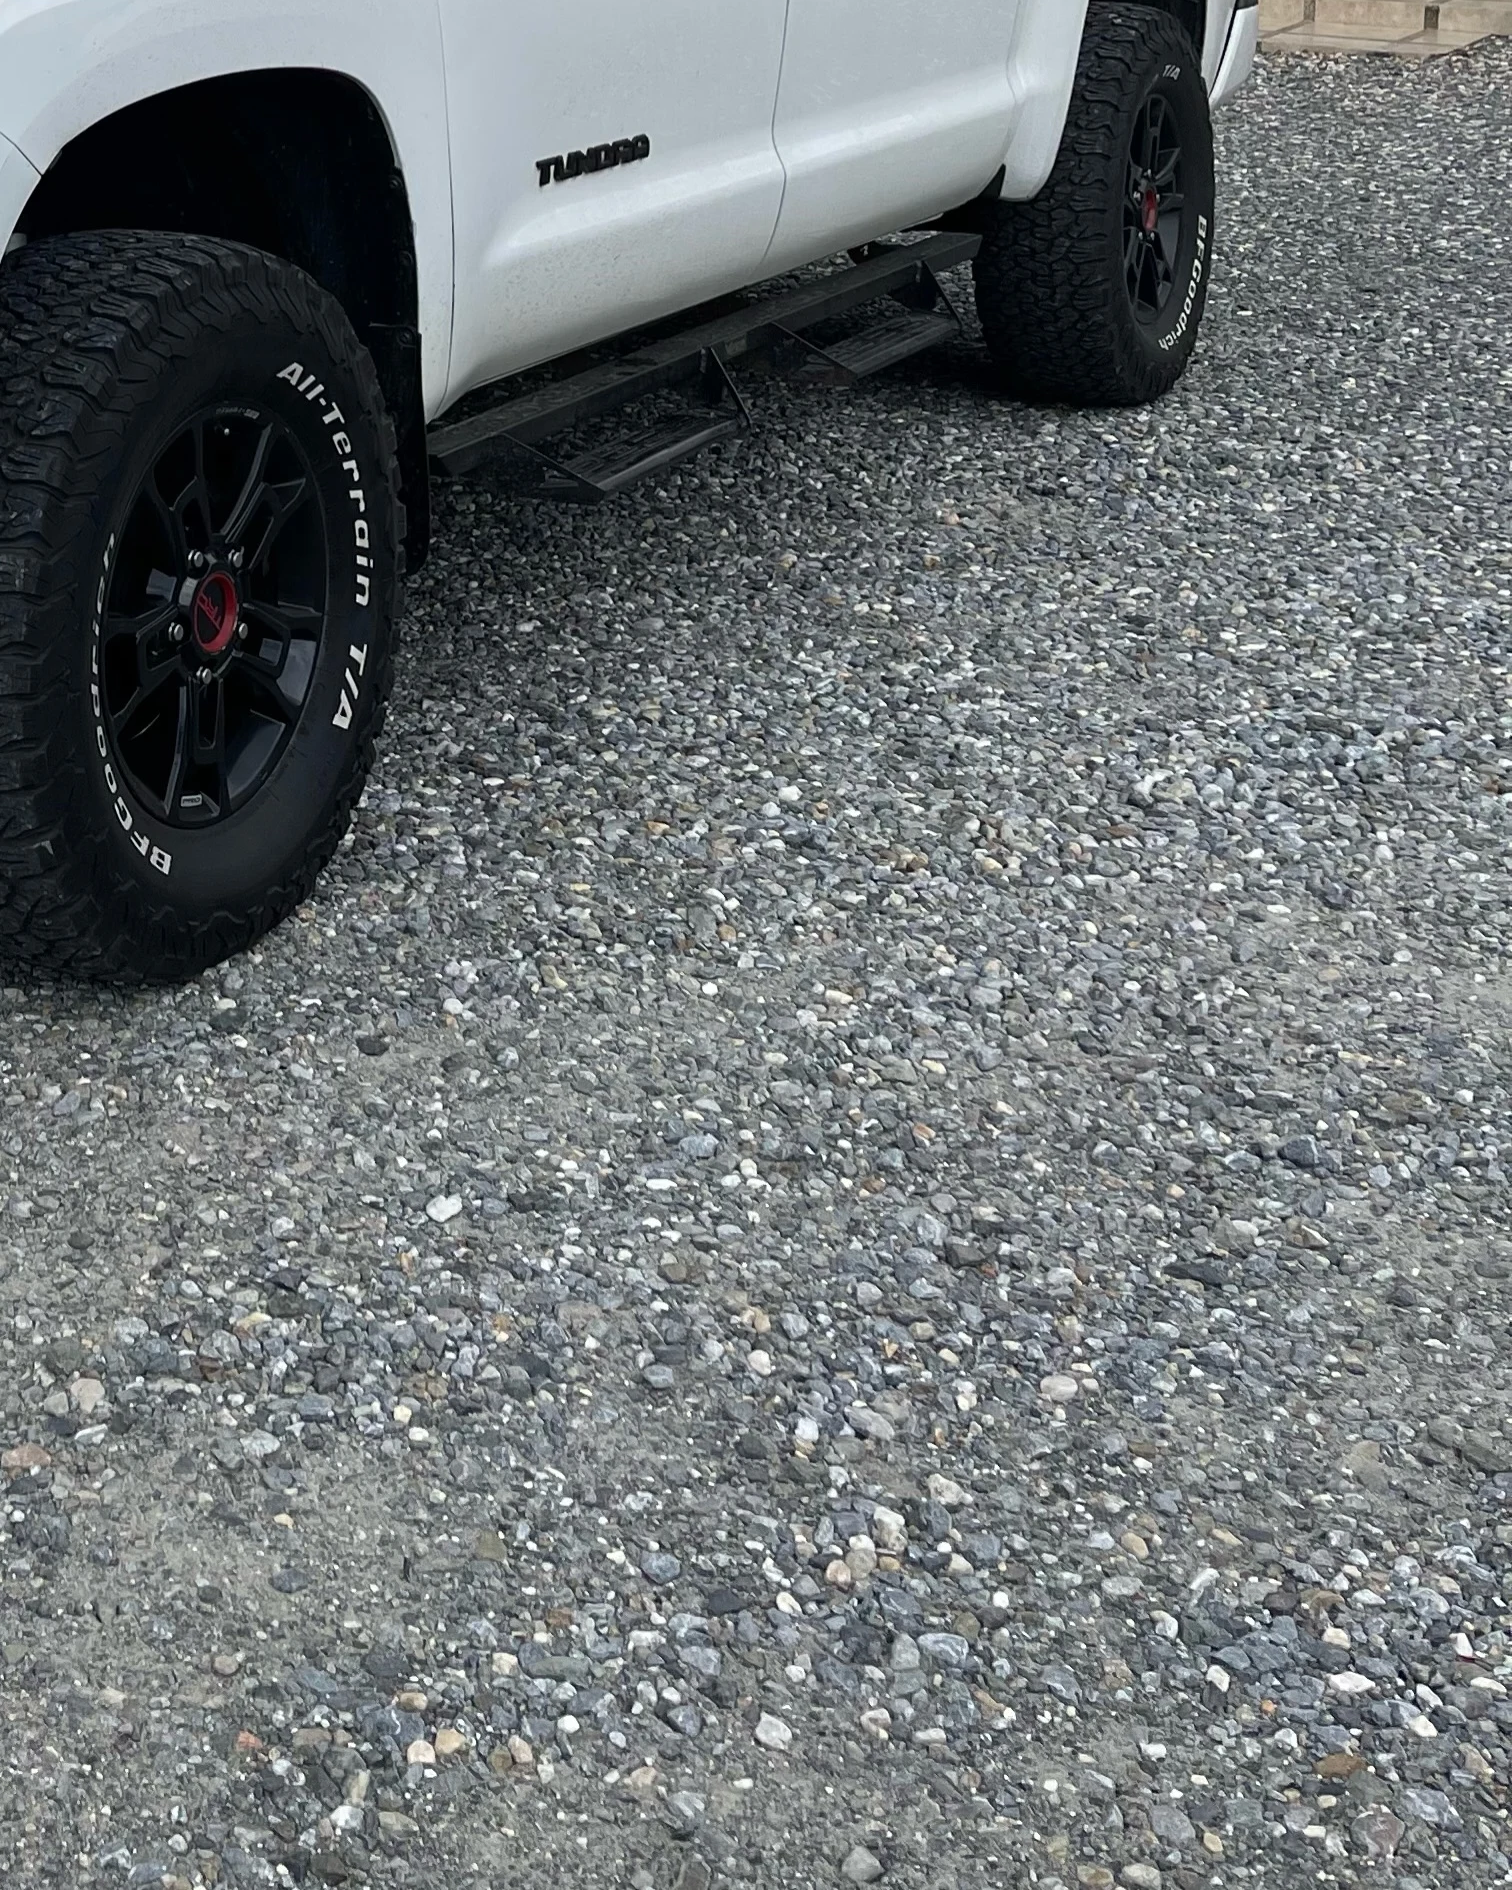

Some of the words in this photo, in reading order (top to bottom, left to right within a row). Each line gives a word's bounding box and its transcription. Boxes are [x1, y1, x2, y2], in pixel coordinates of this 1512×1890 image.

[535, 133, 651, 187] TUNDRA
[1157, 215, 1207, 351] BFGoodrich
[331, 643, 368, 731] T/A
